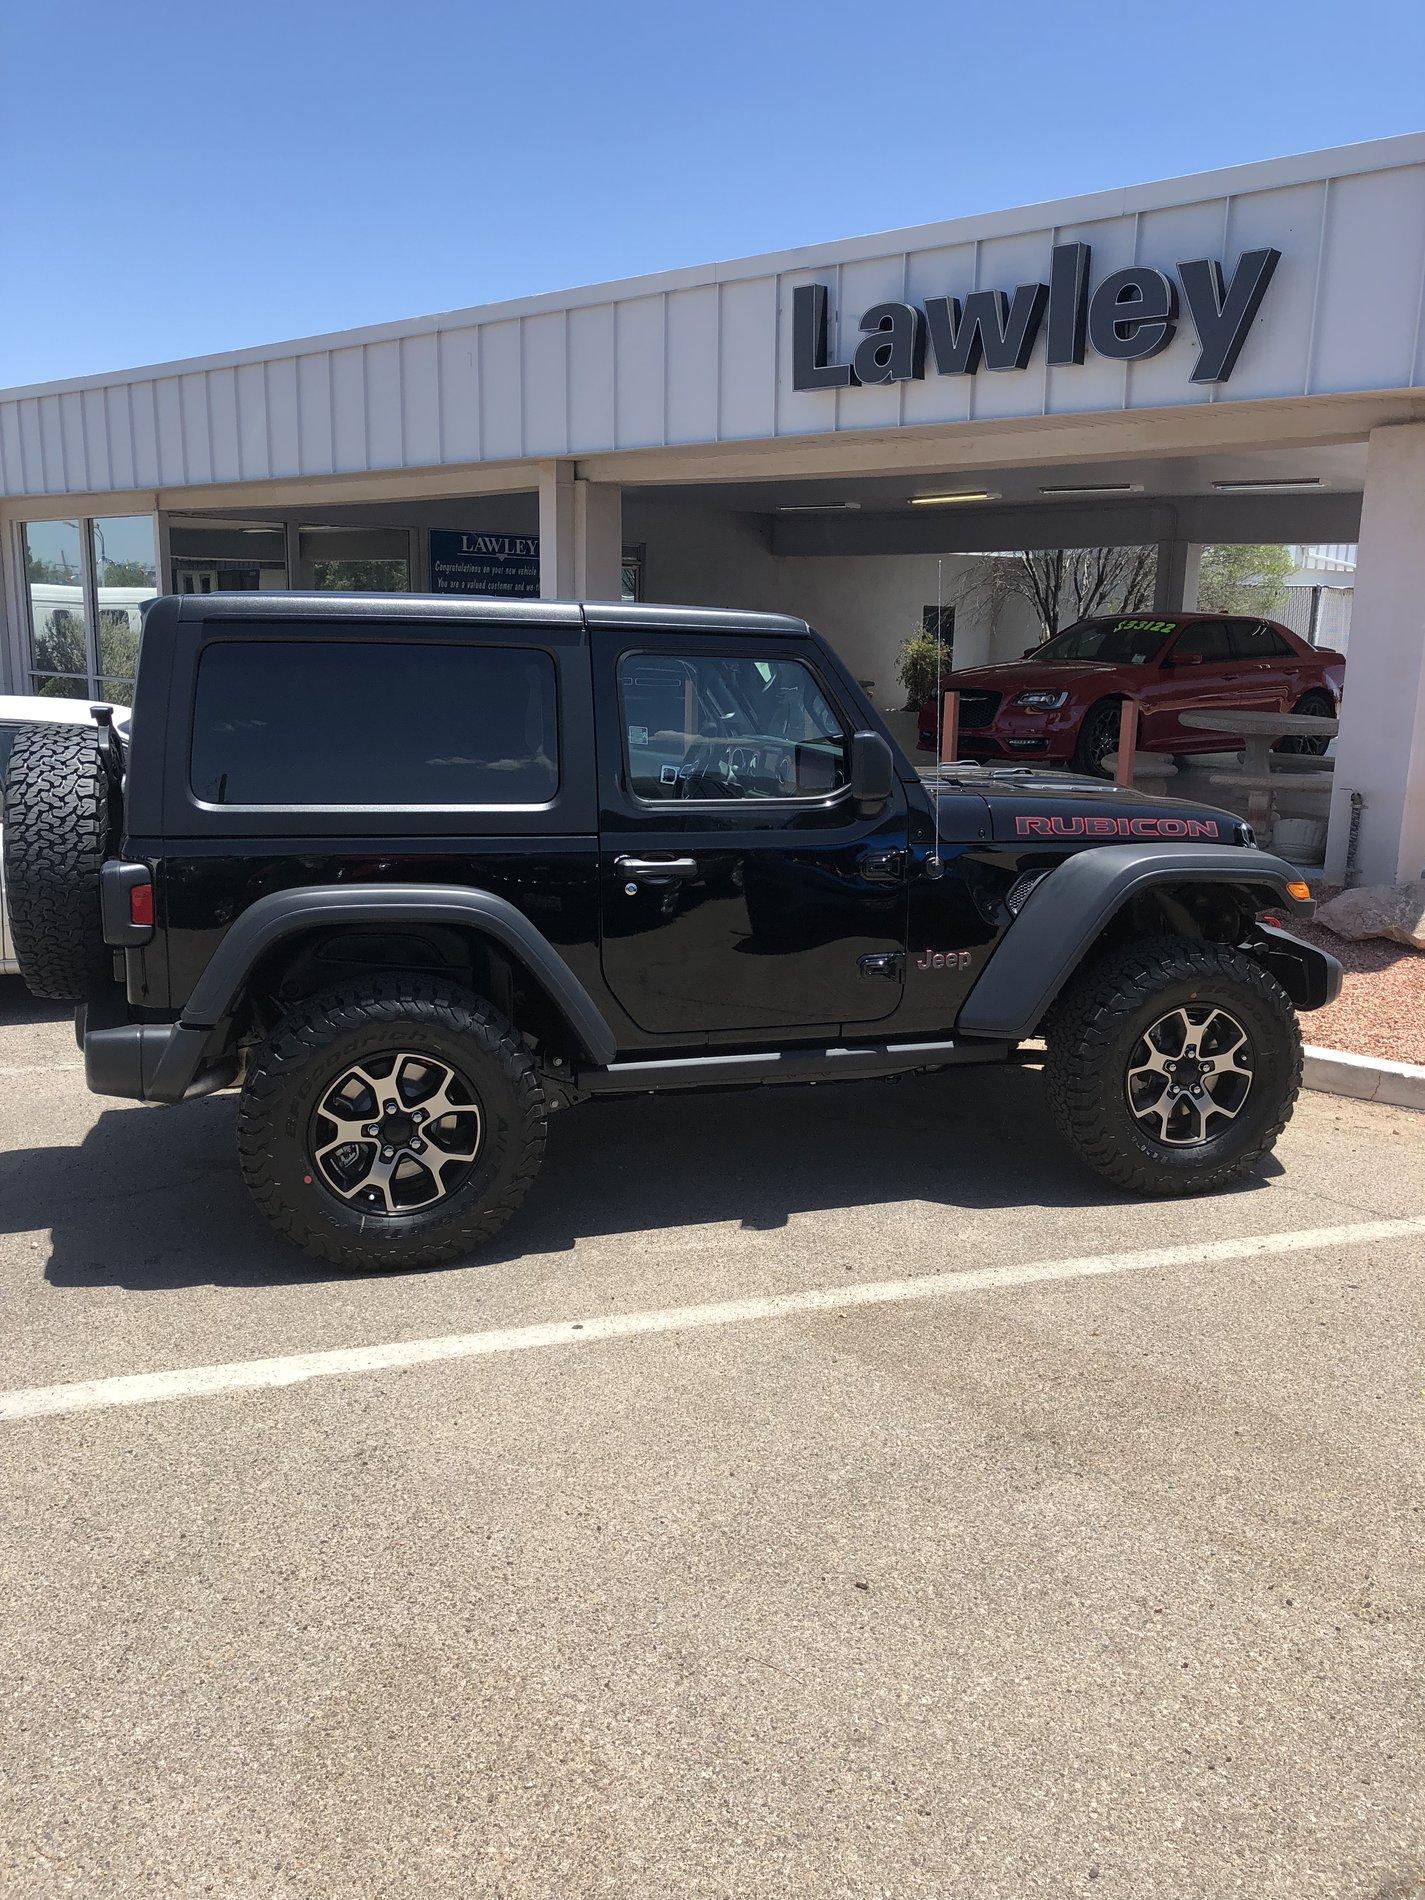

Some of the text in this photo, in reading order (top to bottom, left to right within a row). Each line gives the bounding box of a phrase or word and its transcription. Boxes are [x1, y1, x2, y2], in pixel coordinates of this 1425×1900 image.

[793, 240, 1282, 392] Lawley
[461, 535, 538, 555] LAWLEY
[434, 560, 481, 574] Congratulations
[483, 566, 491, 574] on
[517, 564, 536, 575] vehicle
[437, 577, 448, 588] You
[450, 581, 459, 589] are
[467, 579, 486, 590] valued
[487, 580, 514, 591] customer
[1113, 620, 1176, 633] $33122
[1015, 816, 1219, 838] RUBICON
[917, 949, 972, 971] Jeep
